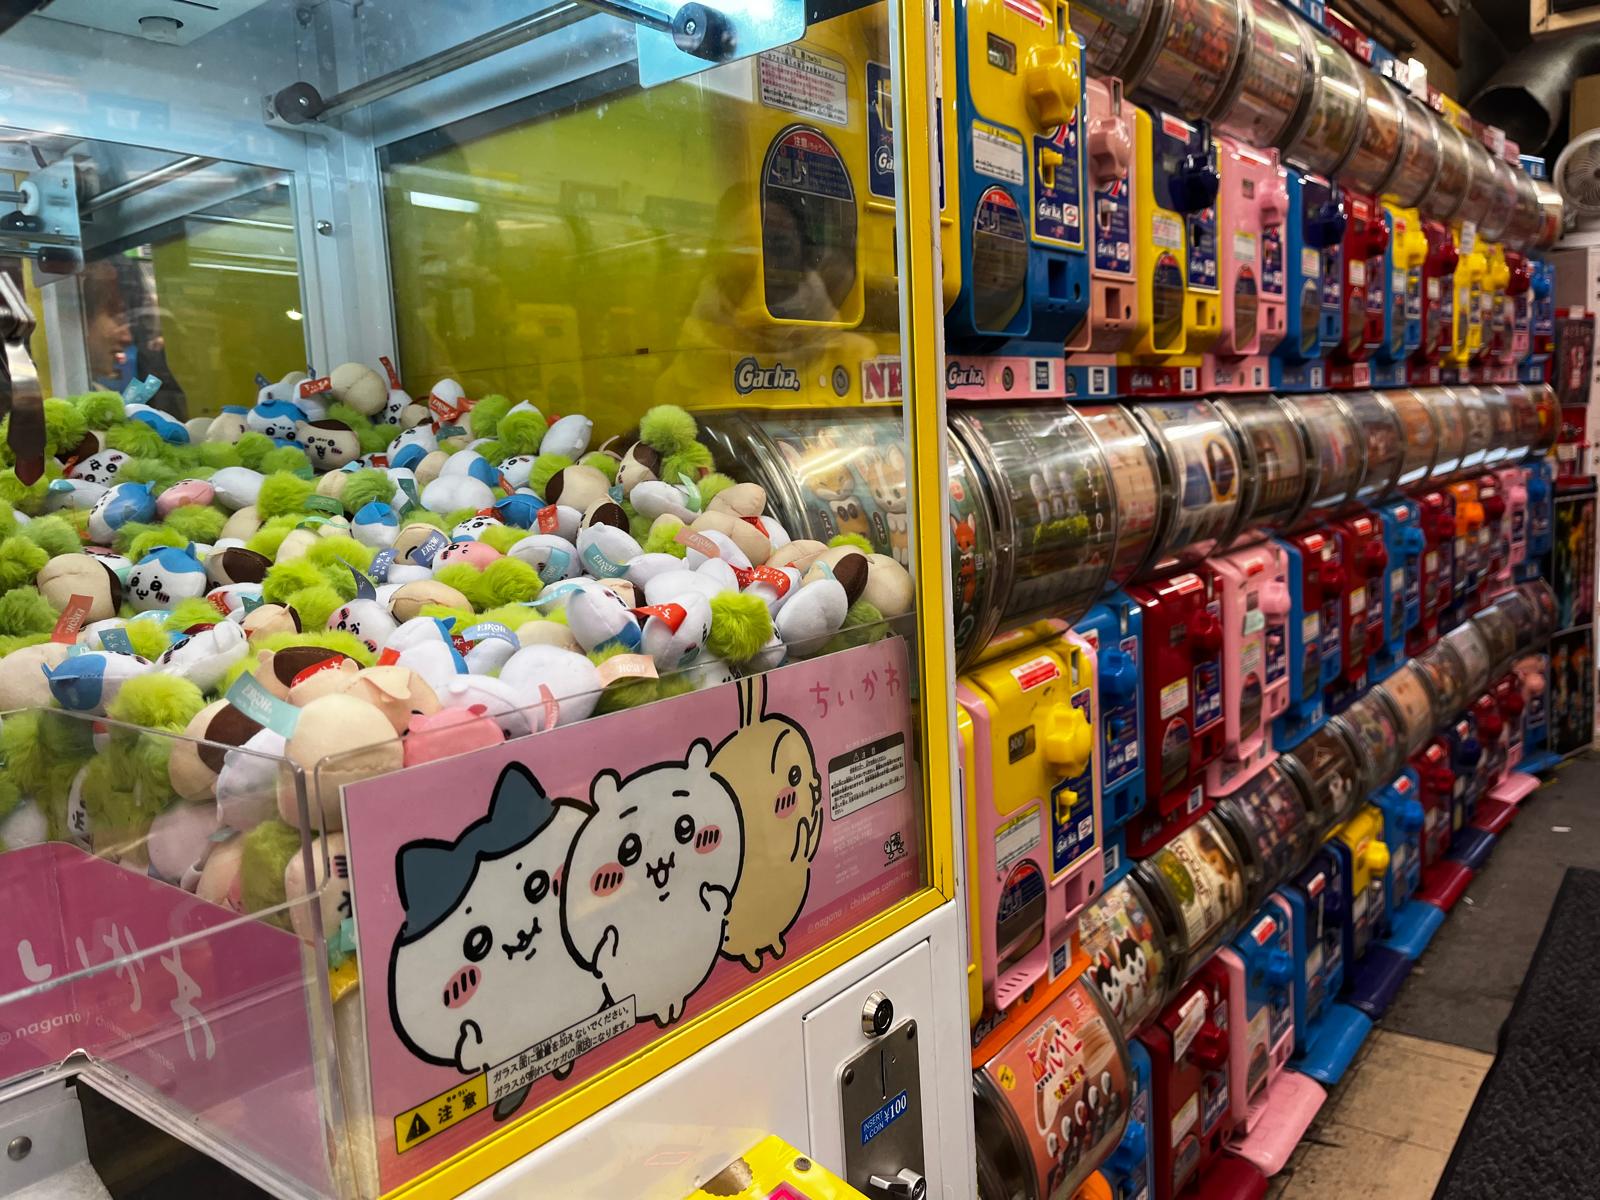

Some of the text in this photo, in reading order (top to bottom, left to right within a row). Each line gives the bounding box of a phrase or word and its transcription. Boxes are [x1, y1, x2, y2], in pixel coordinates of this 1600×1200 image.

[808, 661, 901, 719] ちいかわ
[863, 1110, 884, 1132] INSERT
[884, 1094, 908, 1123] ¥100
[869, 1121, 885, 1138] COIN
